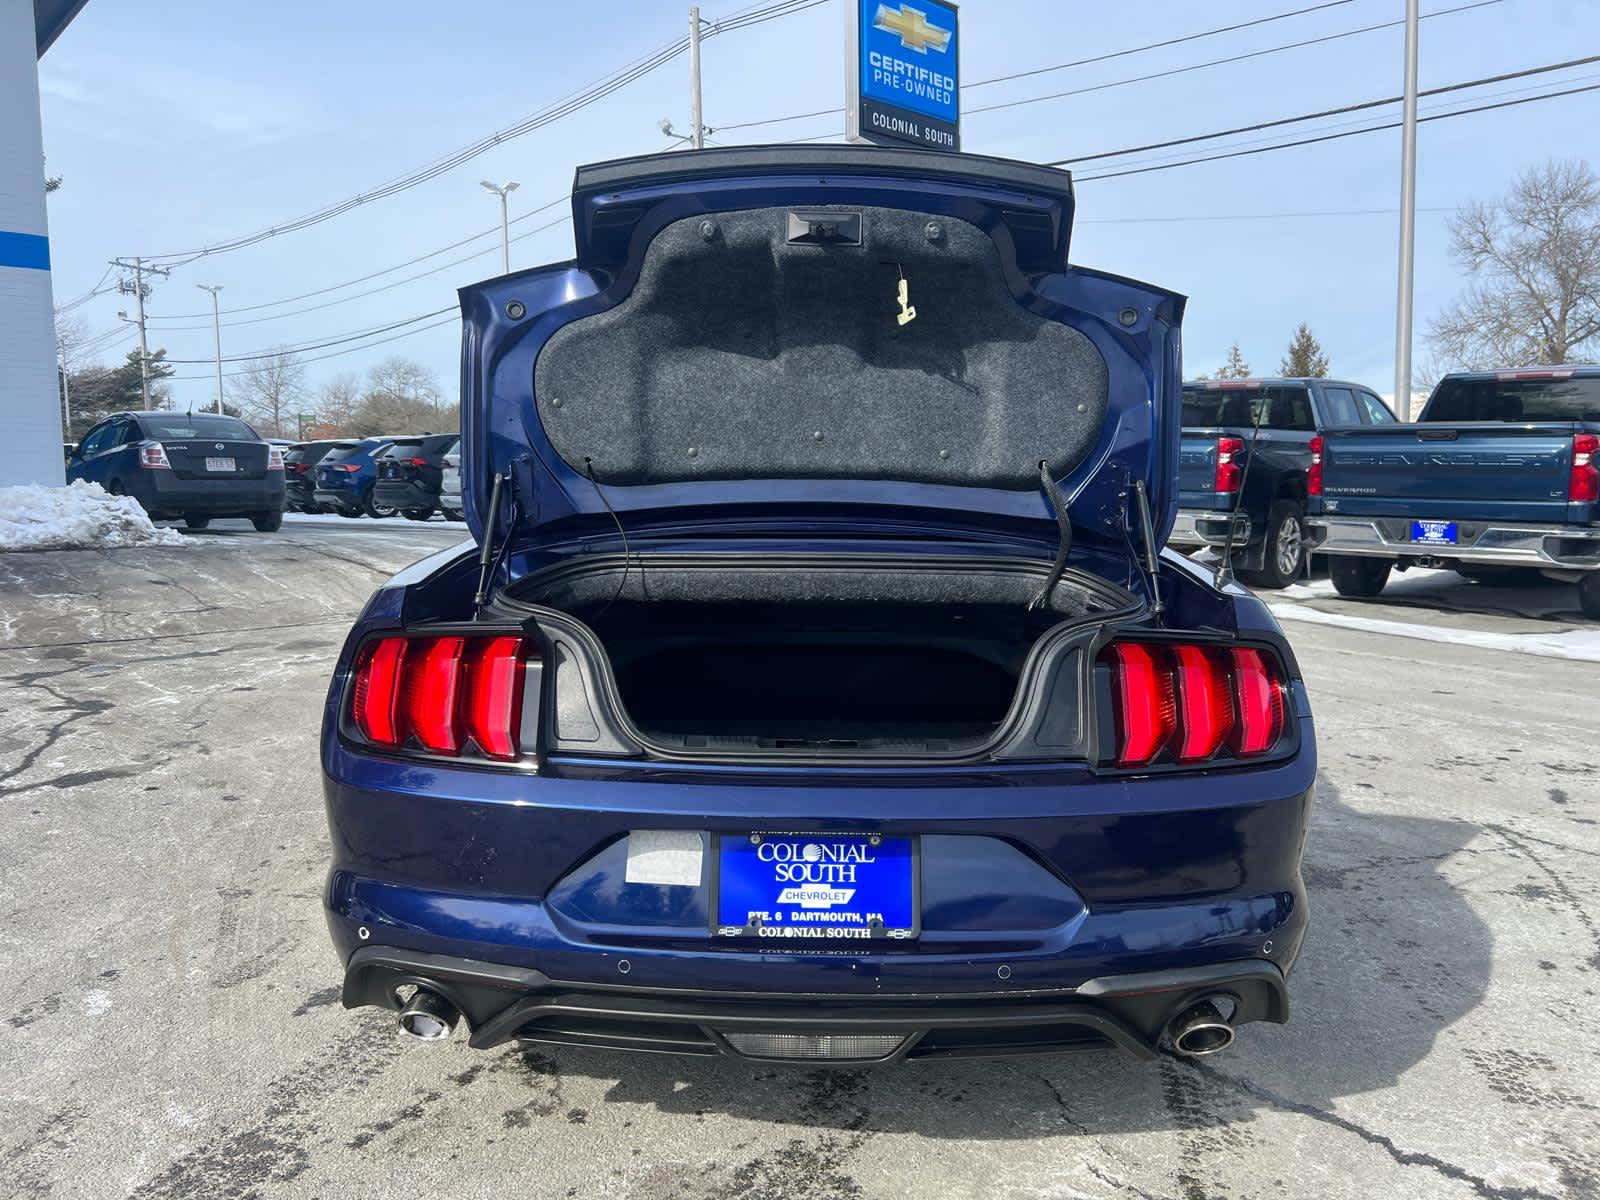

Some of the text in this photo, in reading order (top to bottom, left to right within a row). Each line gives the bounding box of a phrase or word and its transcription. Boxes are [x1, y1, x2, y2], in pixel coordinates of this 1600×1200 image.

[869, 51, 954, 92] CERTIFIED
[874, 69, 951, 105] PRE-OWNED
[872, 112, 953, 146] COLONIAL SOUTH
[757, 843, 875, 863] COLONIAL
[775, 863, 857, 883] SOUTH
[785, 891, 847, 901] CHEVROLET
[774, 912, 782, 921] 6
[791, 911, 864, 924] DARTMOUTH,
[758, 927, 871, 939] COLONIAL SOUTH
